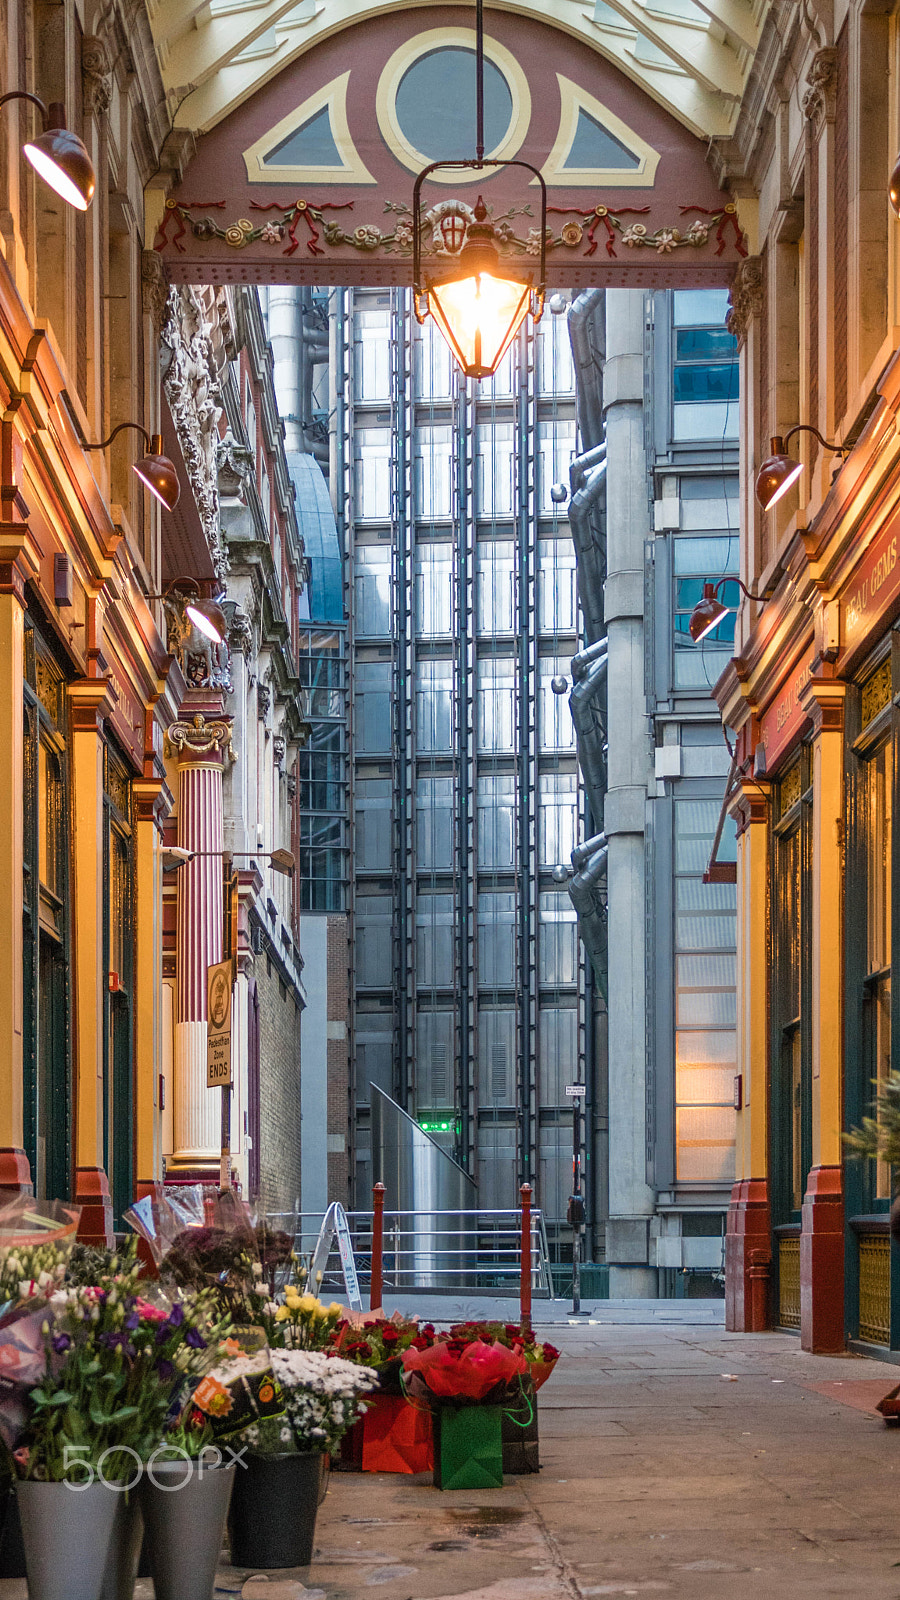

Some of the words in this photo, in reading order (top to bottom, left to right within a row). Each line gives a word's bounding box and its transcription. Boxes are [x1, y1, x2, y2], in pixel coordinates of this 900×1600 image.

[846, 577, 868, 632] BEAU
[870, 536, 897, 597] GEMS
[777, 689, 794, 733] BEAU
[208, 1036, 229, 1048] Pedestrian
[214, 1050, 224, 1059] Zone
[209, 1062, 228, 1078] ENDS
